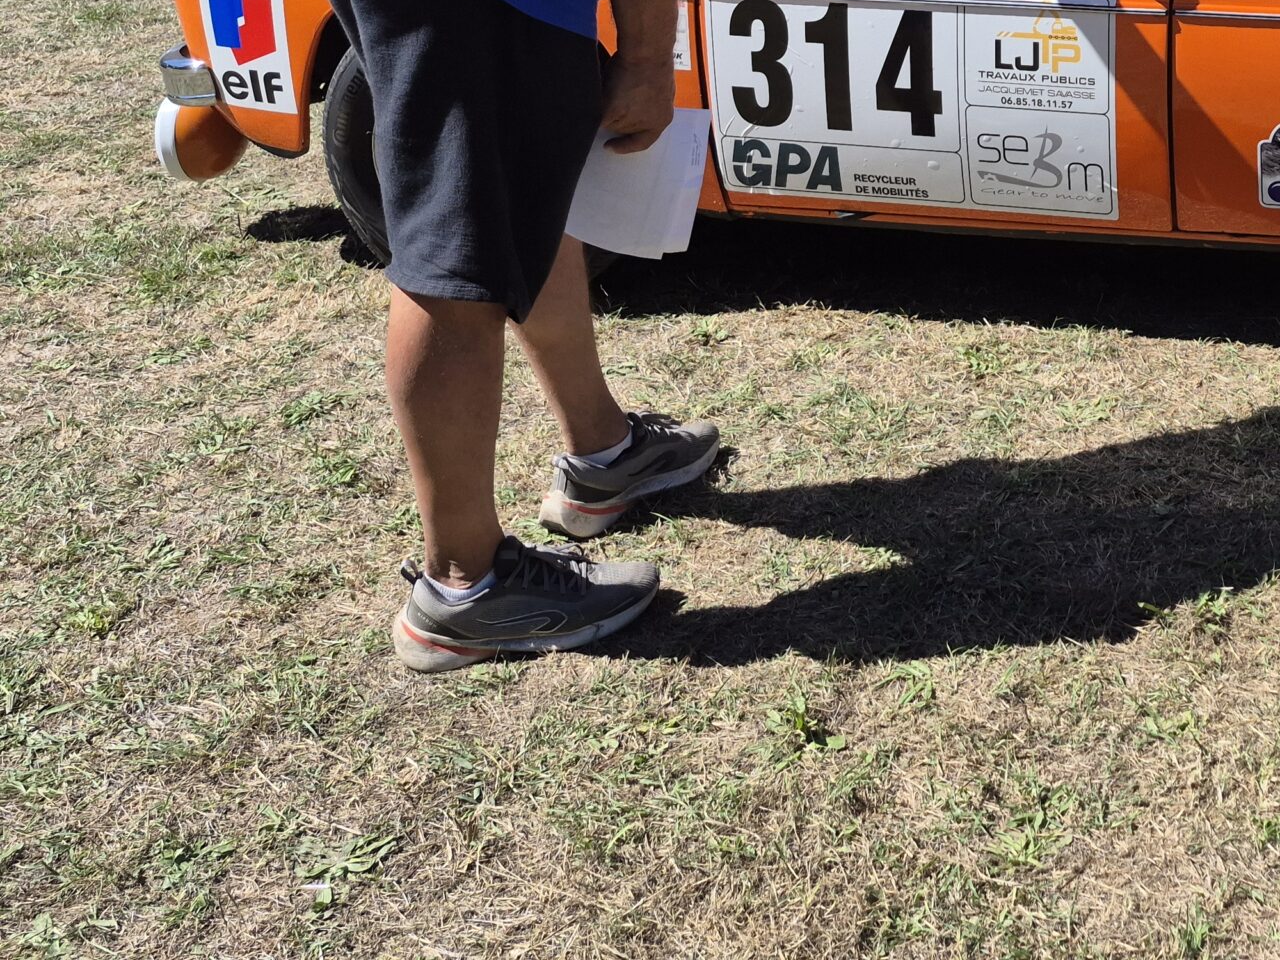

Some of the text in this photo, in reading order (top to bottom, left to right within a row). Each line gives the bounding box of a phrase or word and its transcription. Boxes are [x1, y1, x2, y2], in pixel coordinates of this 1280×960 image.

[978, 70, 1096, 86] TRAVAUX PUBLICS
[222, 69, 284, 105] elf
[978, 85, 1096, 100] JACQUEMET SAVASSE
[1000, 96, 1073, 110] 06.85.18.11.57
[732, 139, 843, 192] GPA
[853, 173, 917, 186] RECYCLEUR
[855, 185, 929, 199] DE MOBILITÉS
[1032, 190, 1049, 198] to
[1056, 193, 1104, 203] move
